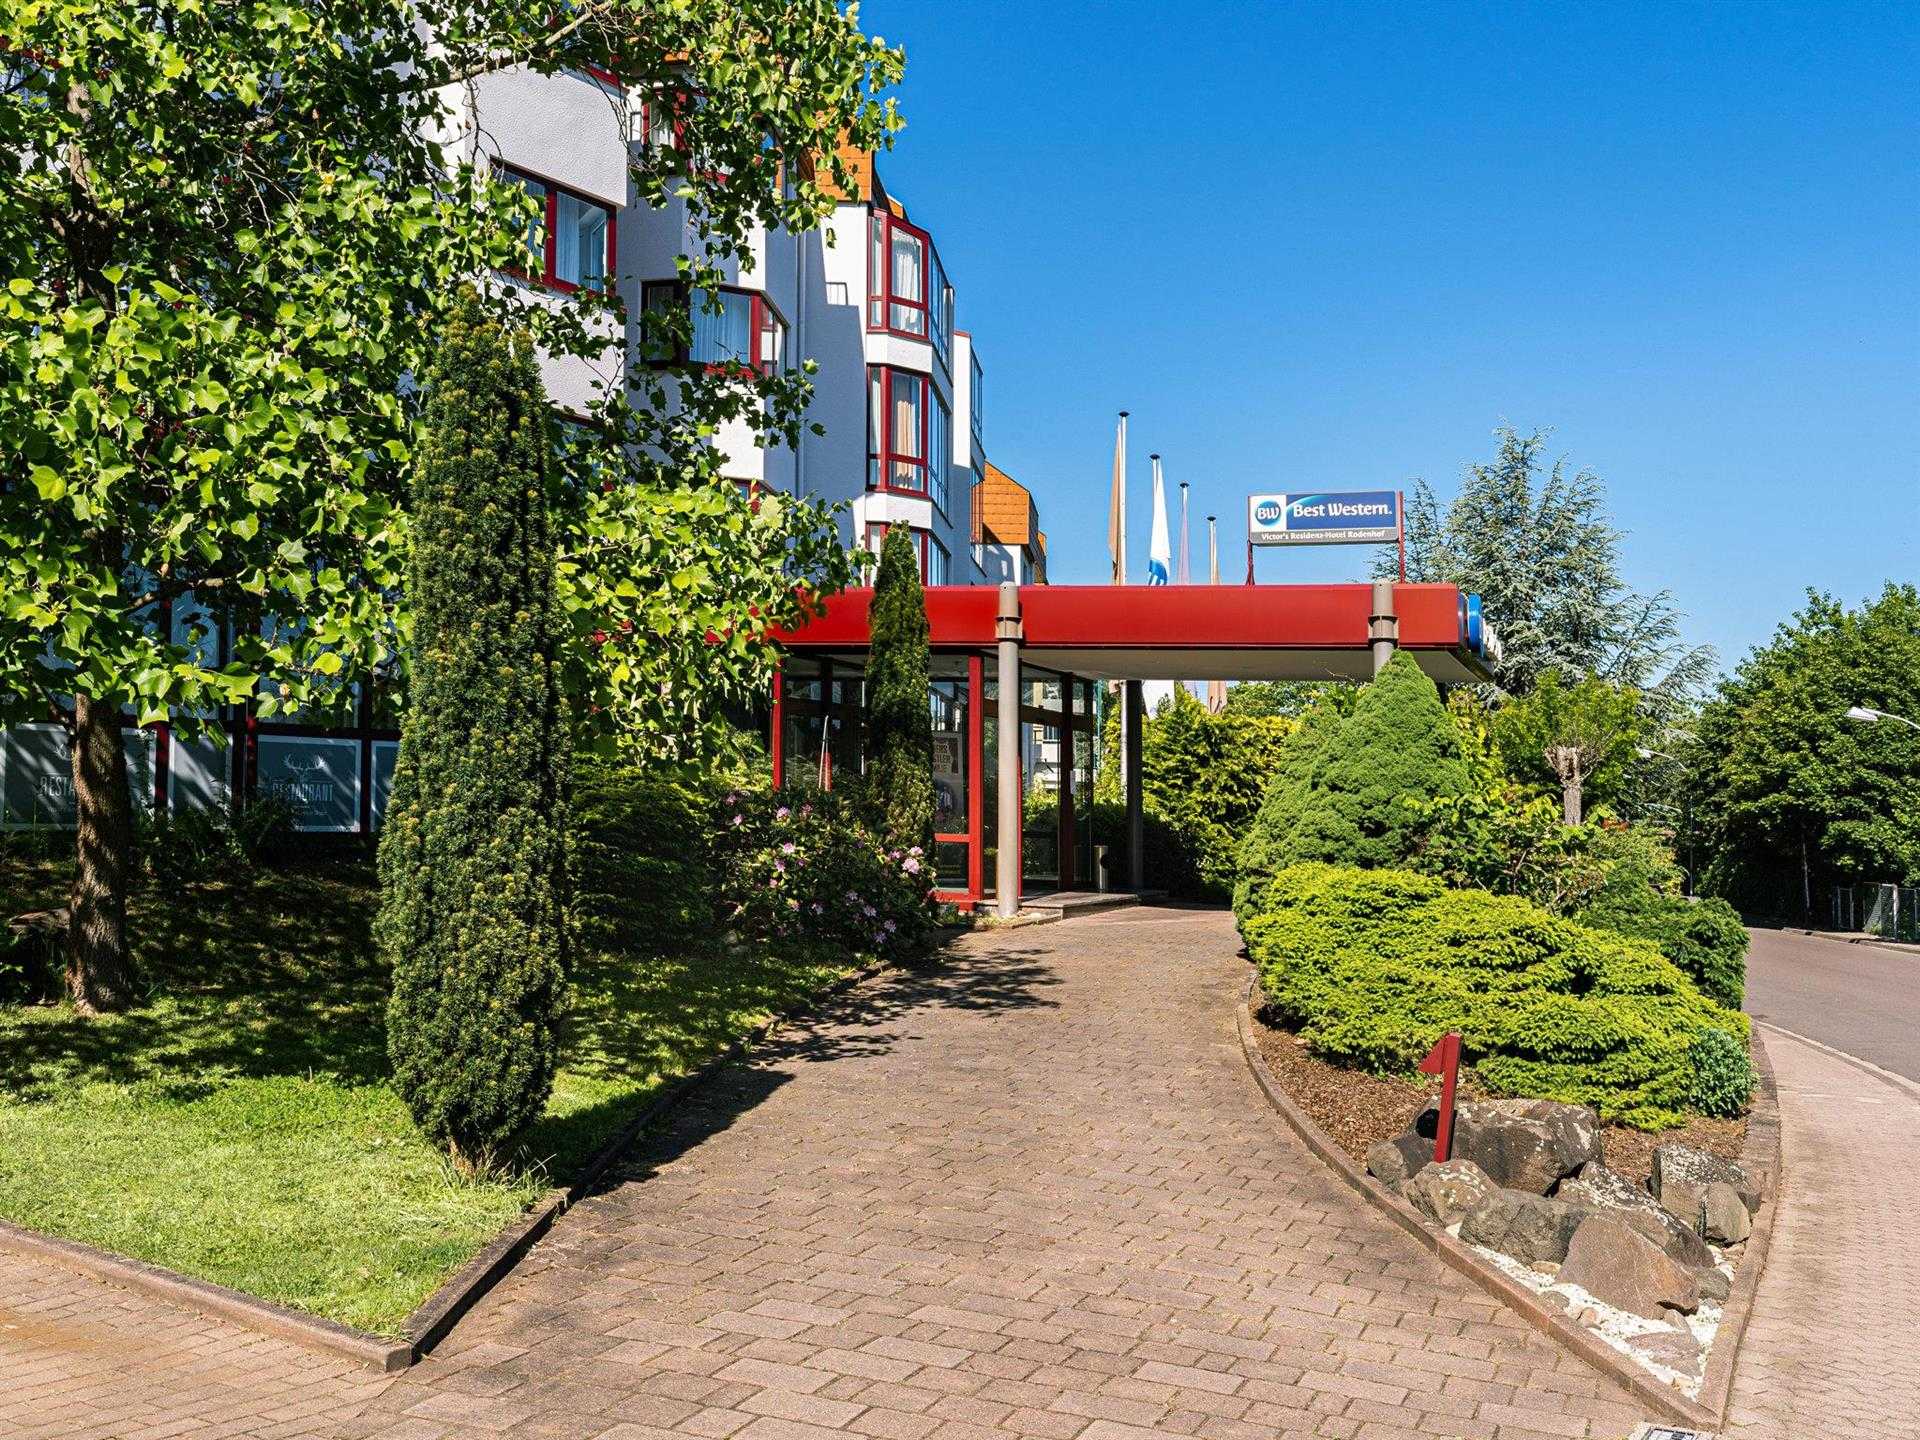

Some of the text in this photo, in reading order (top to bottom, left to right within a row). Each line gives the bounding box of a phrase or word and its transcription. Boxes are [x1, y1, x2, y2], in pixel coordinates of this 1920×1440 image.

[1257, 506, 1280, 519] BW
[1293, 503, 1326, 517] Best
[1262, 532, 1289, 541] Victor's
